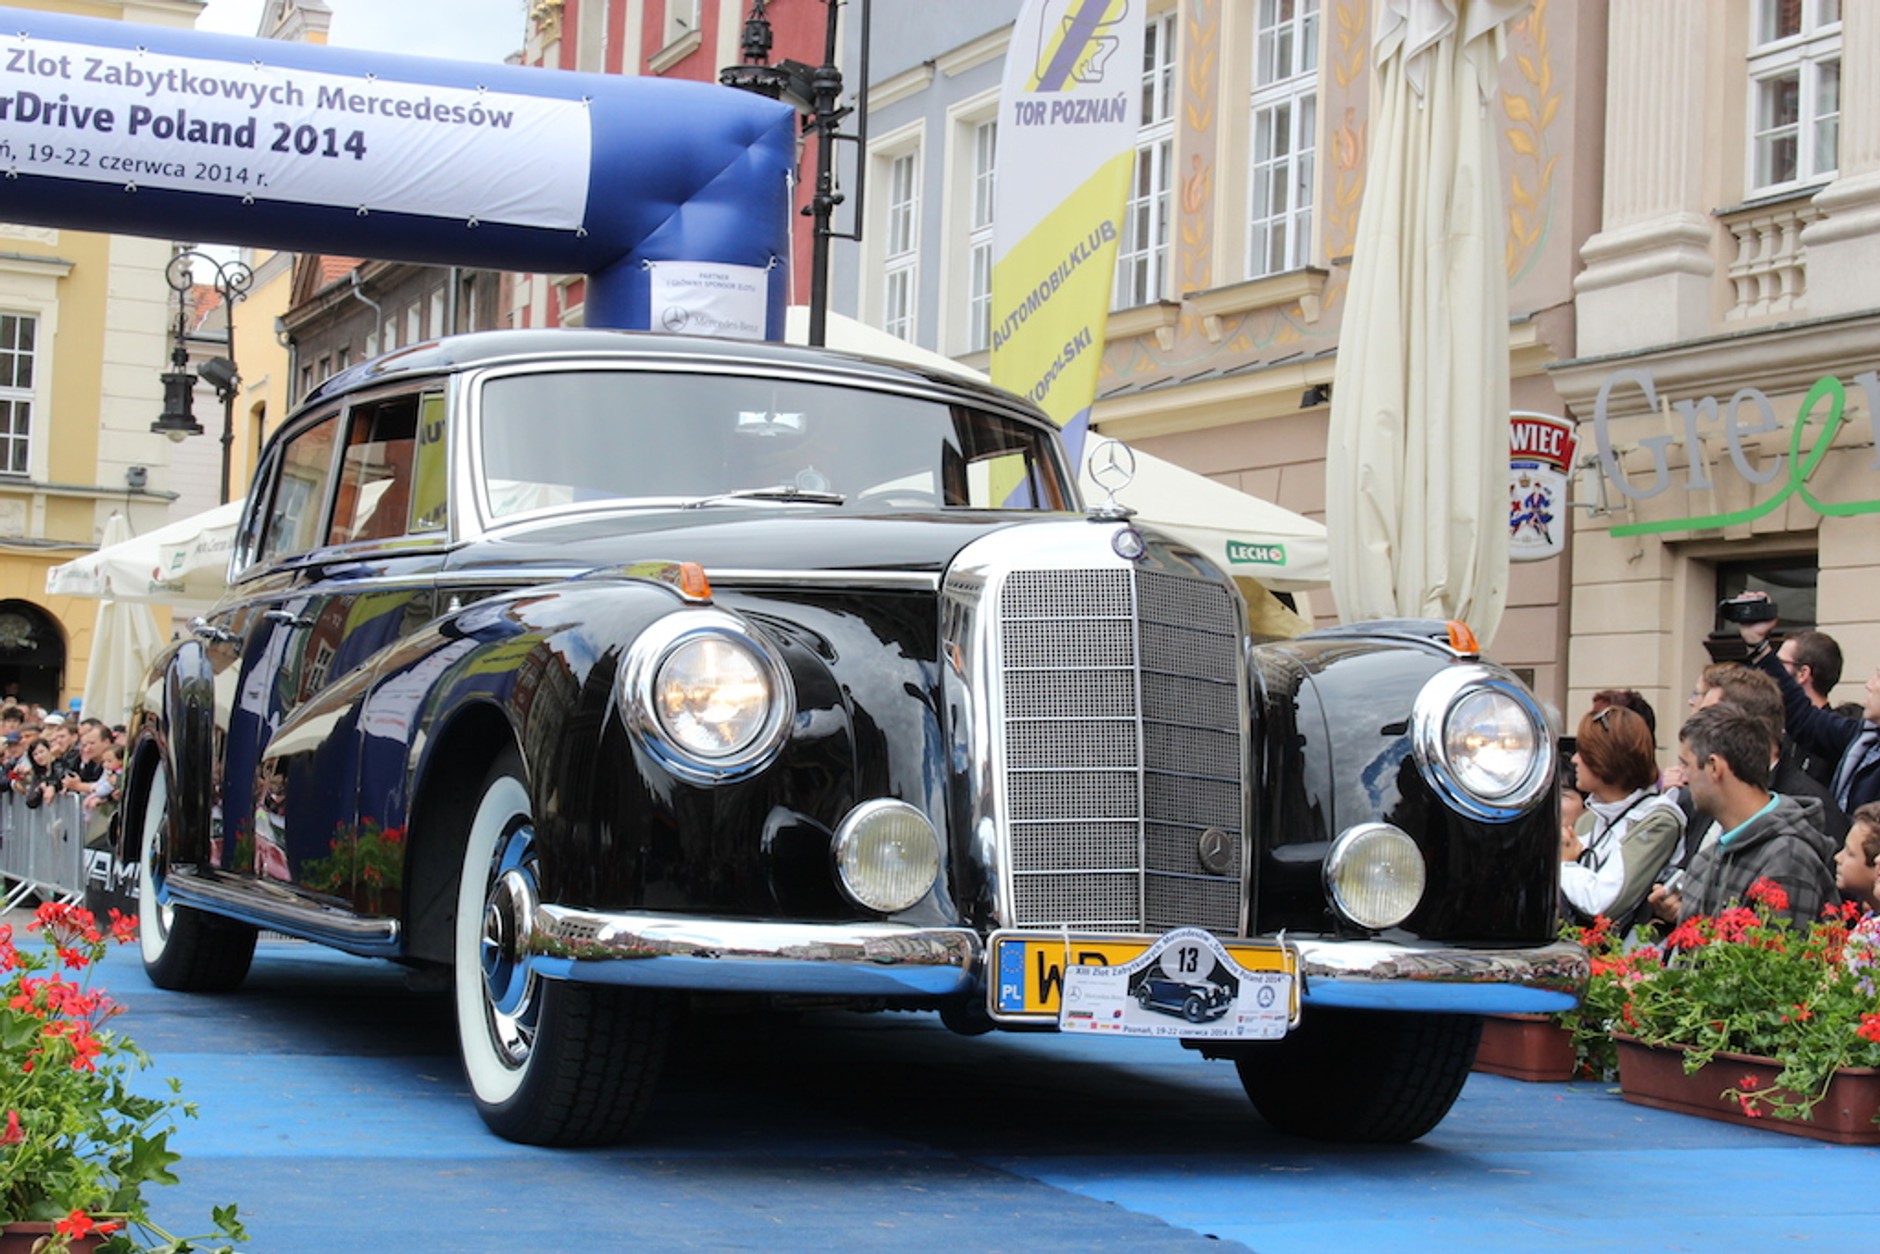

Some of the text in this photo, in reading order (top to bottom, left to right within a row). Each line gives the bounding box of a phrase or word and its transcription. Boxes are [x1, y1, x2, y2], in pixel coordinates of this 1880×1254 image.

[5, 47, 514, 129] Zlot Zabytkowych Mercedesów
[1015, 91, 1127, 126] TOR POZNAŃ
[128, 104, 256, 149] Poland
[271, 121, 367, 160] 2014
[28, 143, 91, 167] 19-22
[99, 154, 186, 178] czerwca
[195, 162, 249, 184] 2014
[256, 172, 269, 187] r.
[992, 219, 1118, 353] AUTOMOBILKLUB
[1230, 544, 1268, 562] LECH
[1178, 946, 1199, 973] 13
[1002, 984, 1022, 1001] PL
